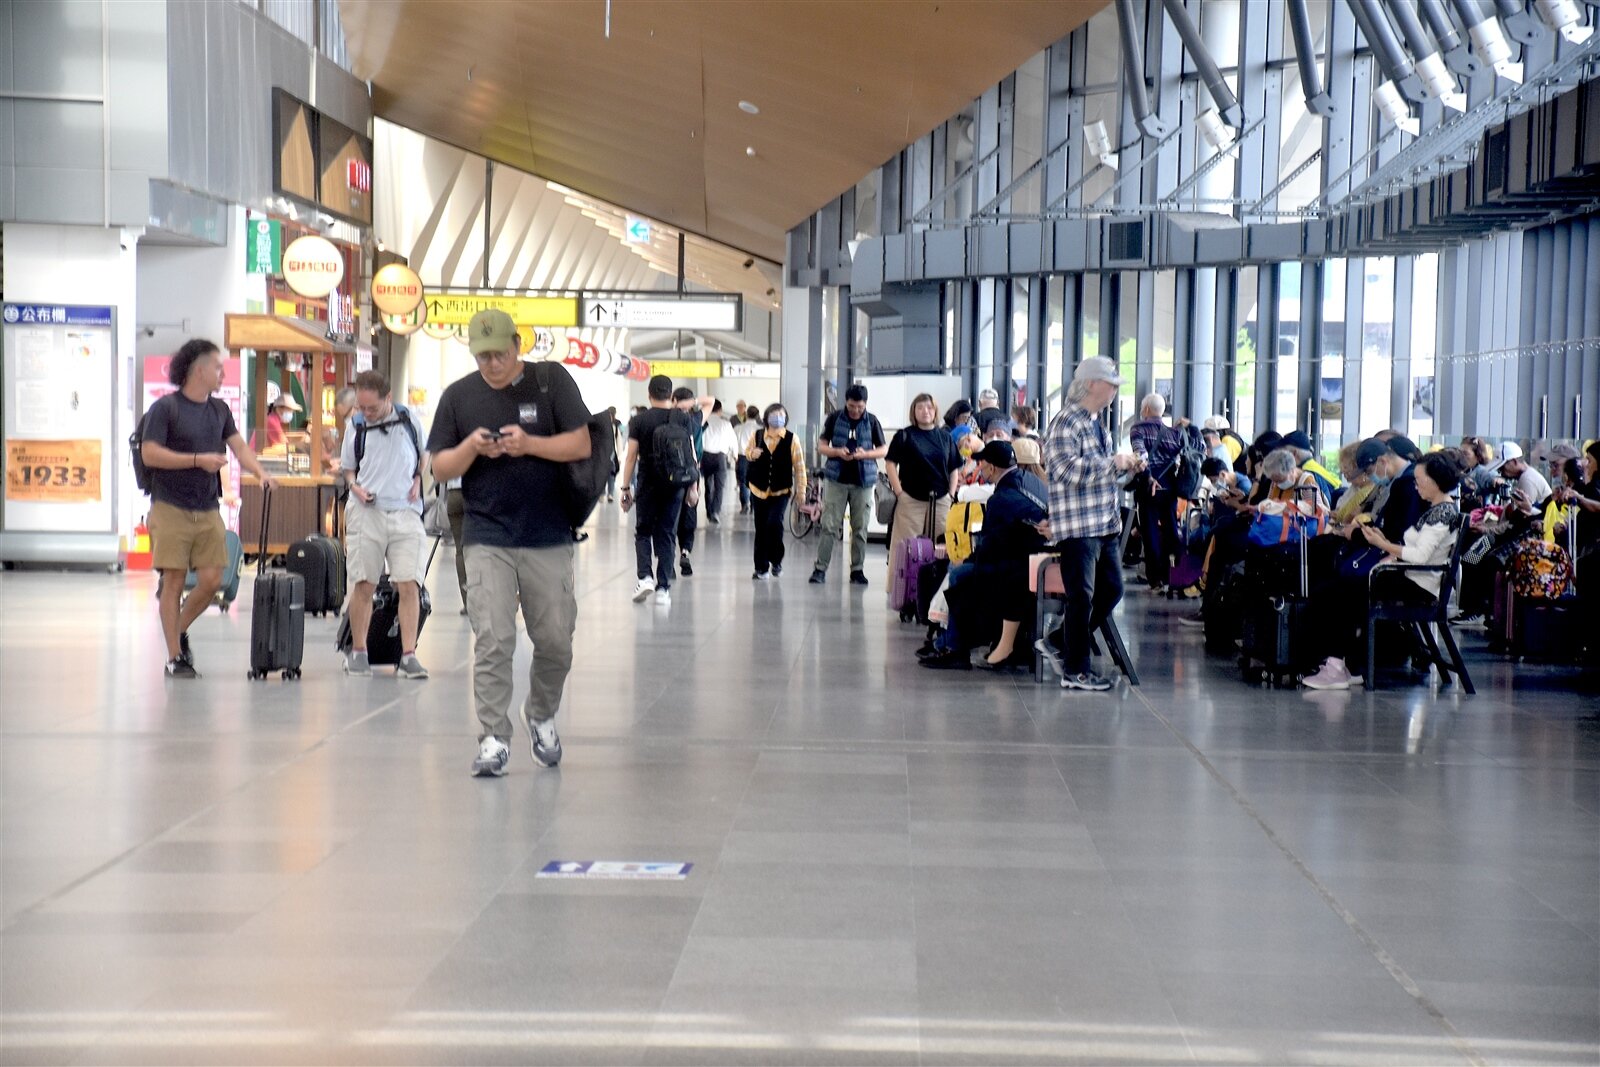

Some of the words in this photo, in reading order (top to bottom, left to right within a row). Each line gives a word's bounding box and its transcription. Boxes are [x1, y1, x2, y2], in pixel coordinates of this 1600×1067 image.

[255, 263, 273, 273] ATM
[22, 306, 66, 323] 公布欄
[446, 300, 488, 314] 西出口
[21, 465, 87, 487] 1933
